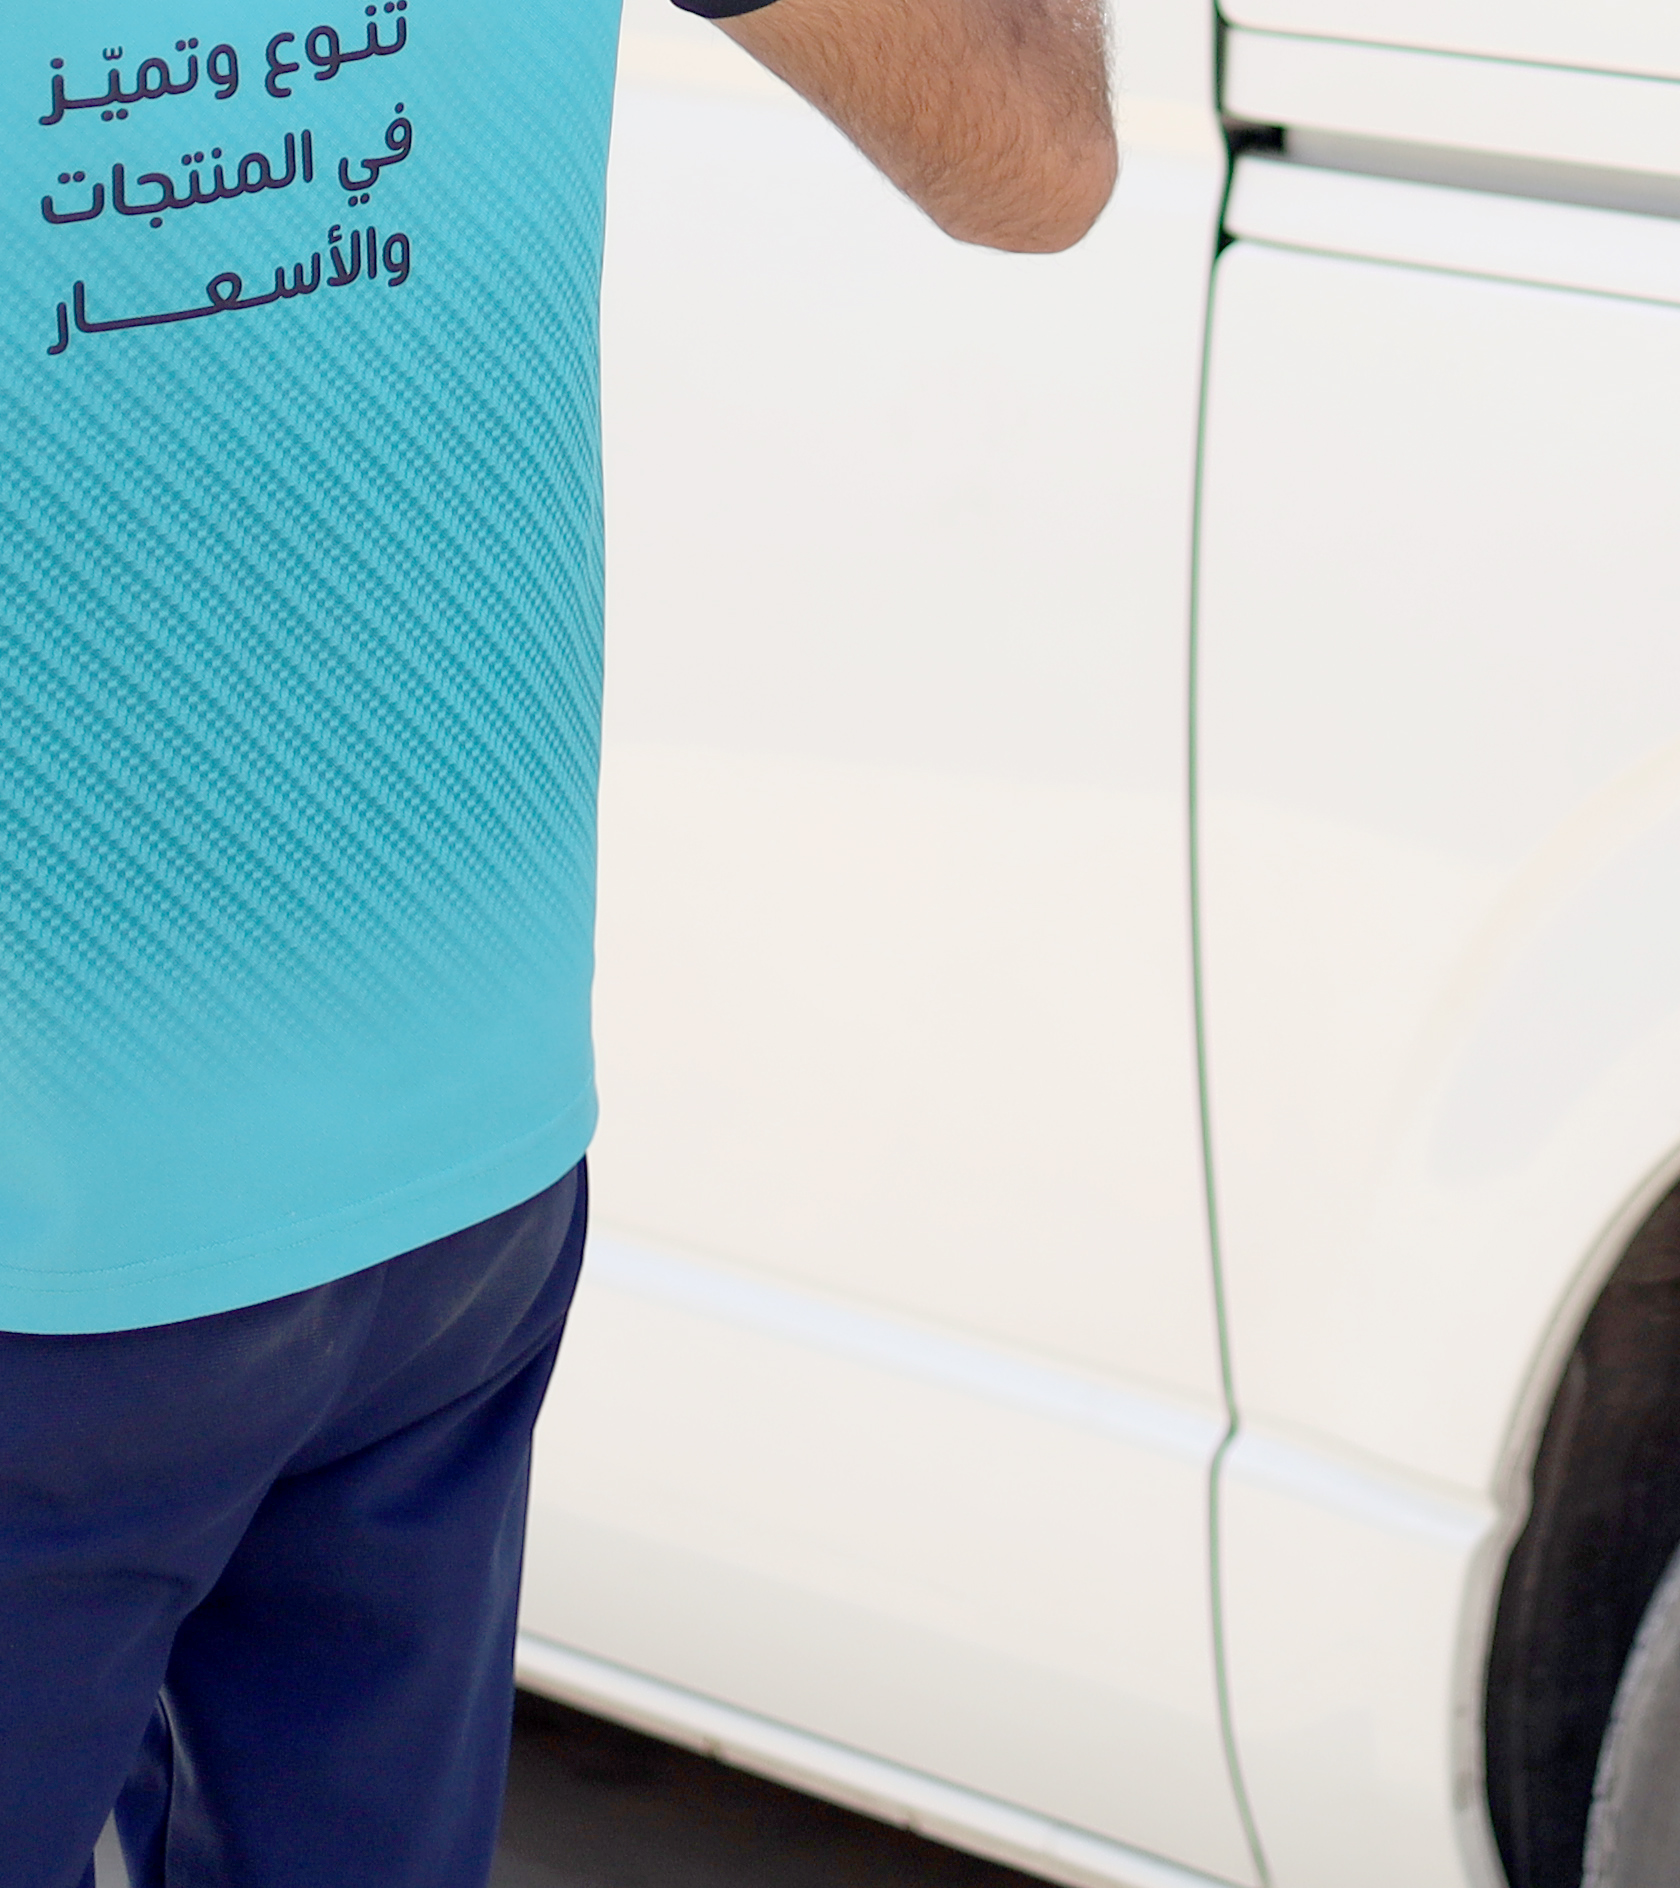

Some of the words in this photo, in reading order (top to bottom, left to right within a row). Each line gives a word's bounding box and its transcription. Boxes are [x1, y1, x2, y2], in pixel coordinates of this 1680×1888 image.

[40, 129, 313, 229] المنتجات
[338, 102, 413, 207] في
[46, 223, 411, 356] والأسعار
